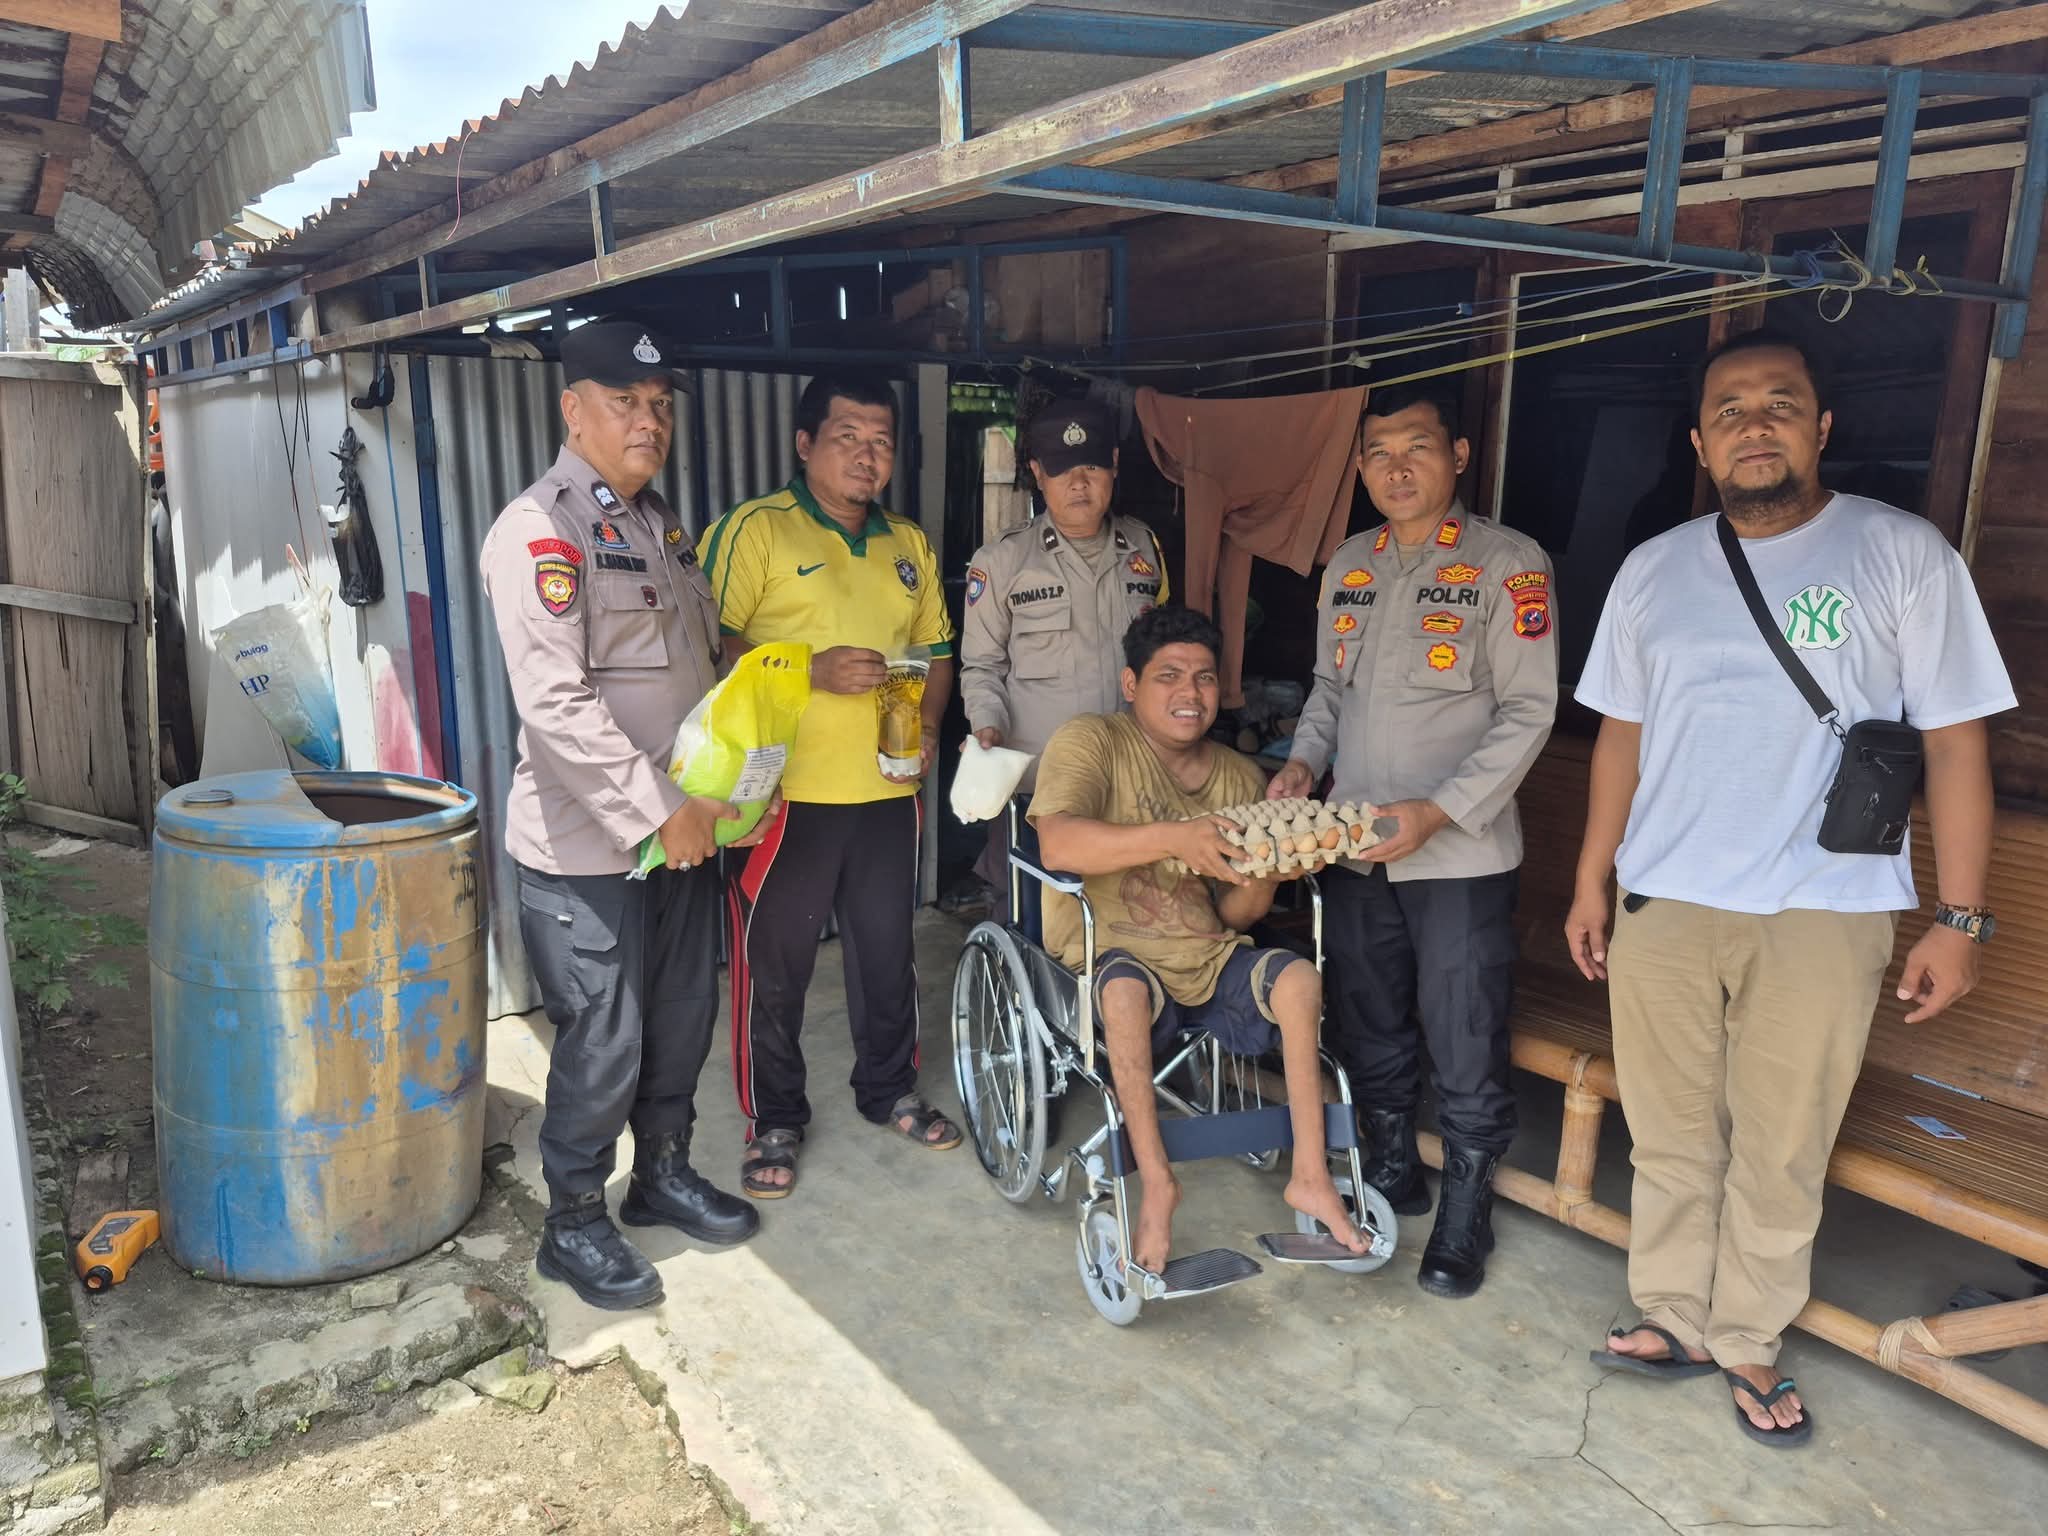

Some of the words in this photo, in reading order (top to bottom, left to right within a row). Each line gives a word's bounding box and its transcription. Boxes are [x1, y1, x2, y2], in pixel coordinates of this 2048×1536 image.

[1507, 574, 1545, 589] POLRES
[1010, 587, 1048, 606] THOMAS
[1416, 587, 1480, 607] POLRI
[1786, 590, 1843, 643] NY
[239, 644, 269, 658] bulog
